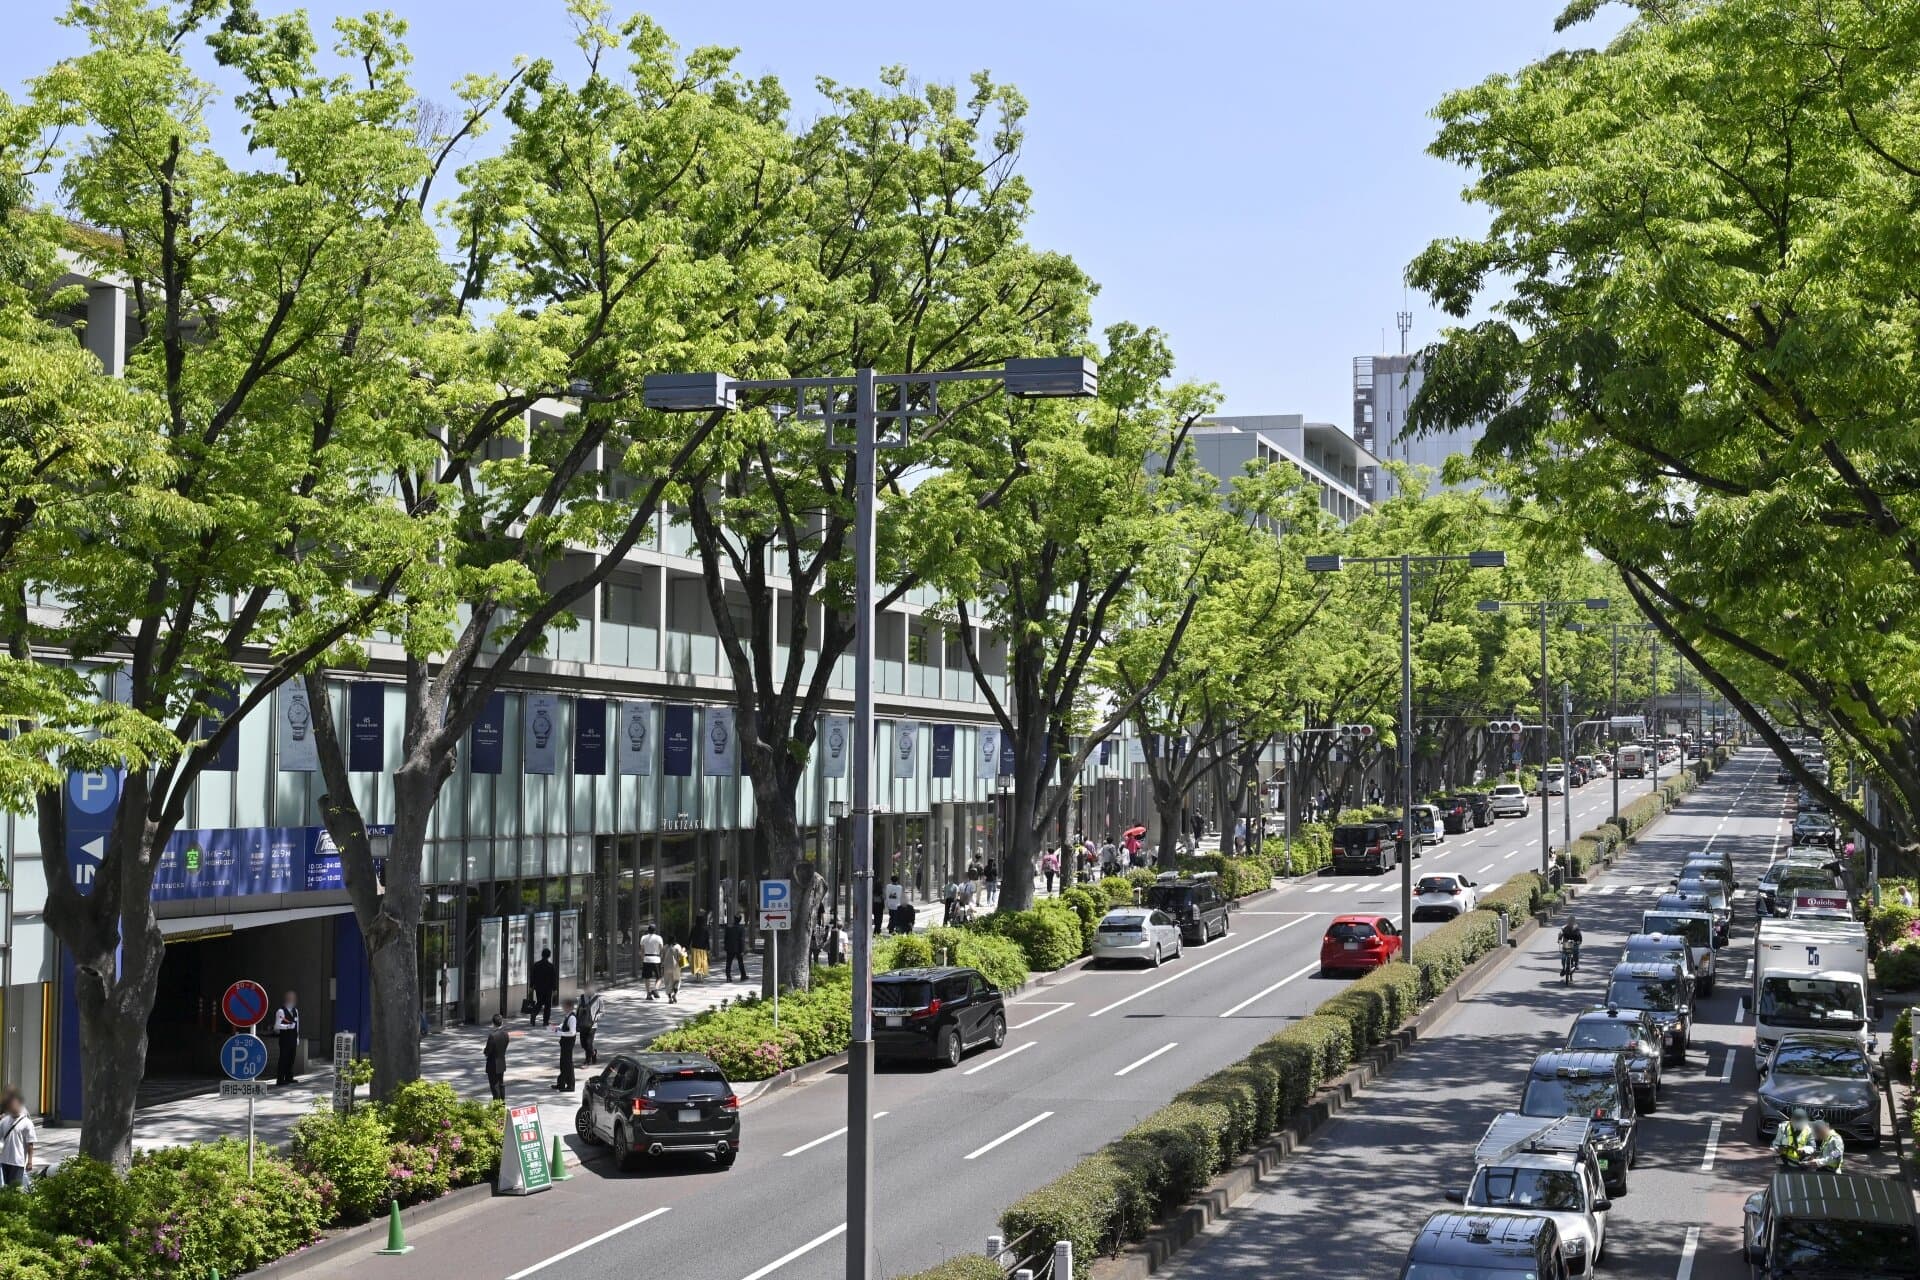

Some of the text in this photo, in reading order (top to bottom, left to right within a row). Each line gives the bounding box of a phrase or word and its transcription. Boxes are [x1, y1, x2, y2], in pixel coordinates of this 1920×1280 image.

[82, 772, 108, 801] P
[367, 827, 386, 836] KING
[186, 848, 199, 869] 空
[763, 882, 787, 909] P
[231, 1046, 249, 1075] P
